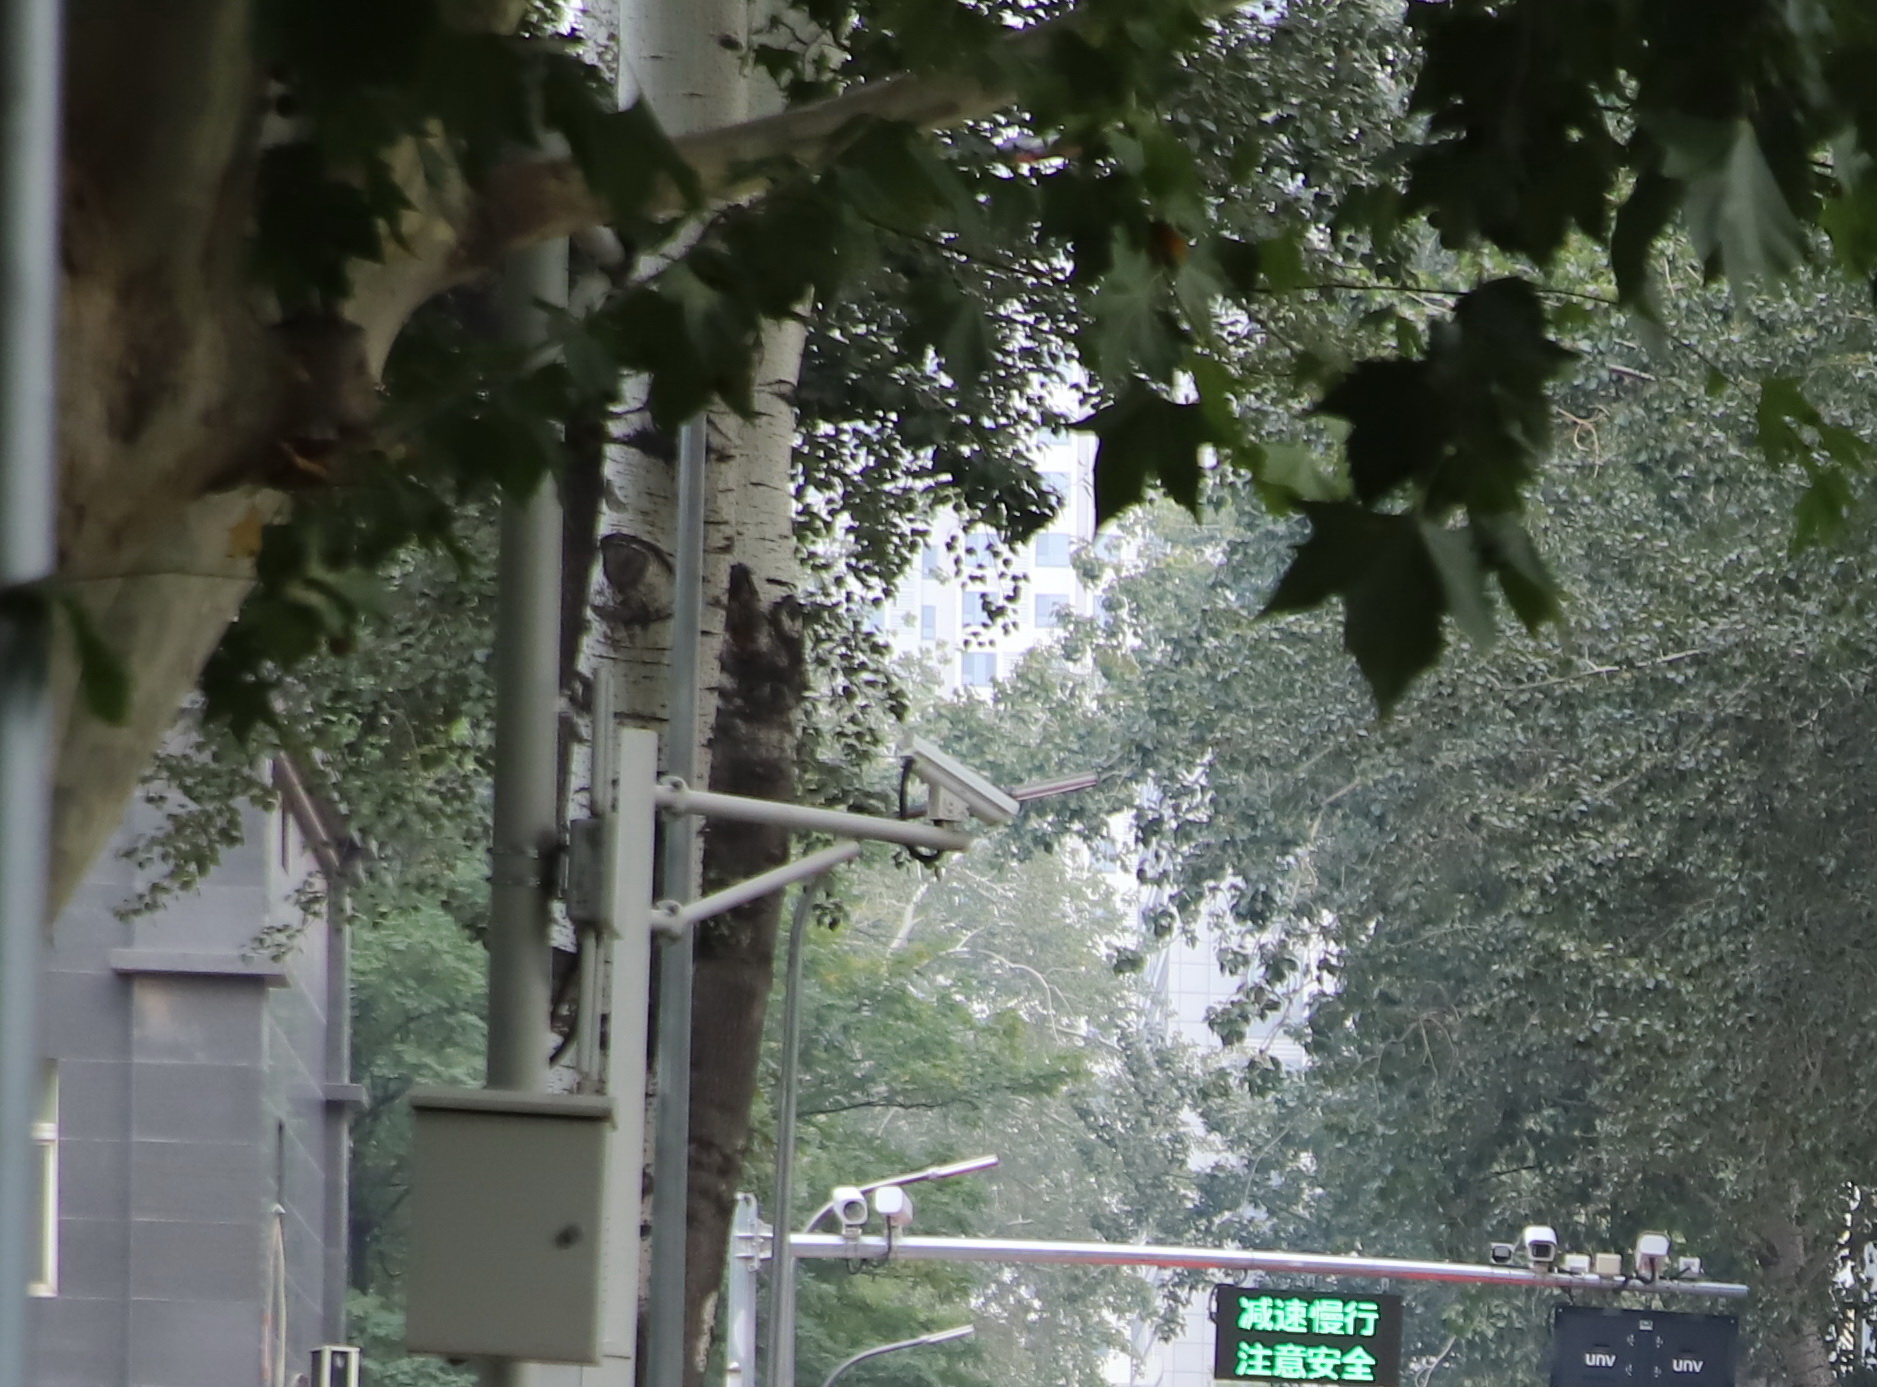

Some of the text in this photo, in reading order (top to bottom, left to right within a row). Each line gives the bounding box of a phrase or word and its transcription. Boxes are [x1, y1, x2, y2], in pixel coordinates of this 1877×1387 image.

[1237, 1295, 1380, 1337] 减速慢行
[1235, 1340, 1377, 1381] 注意安全
